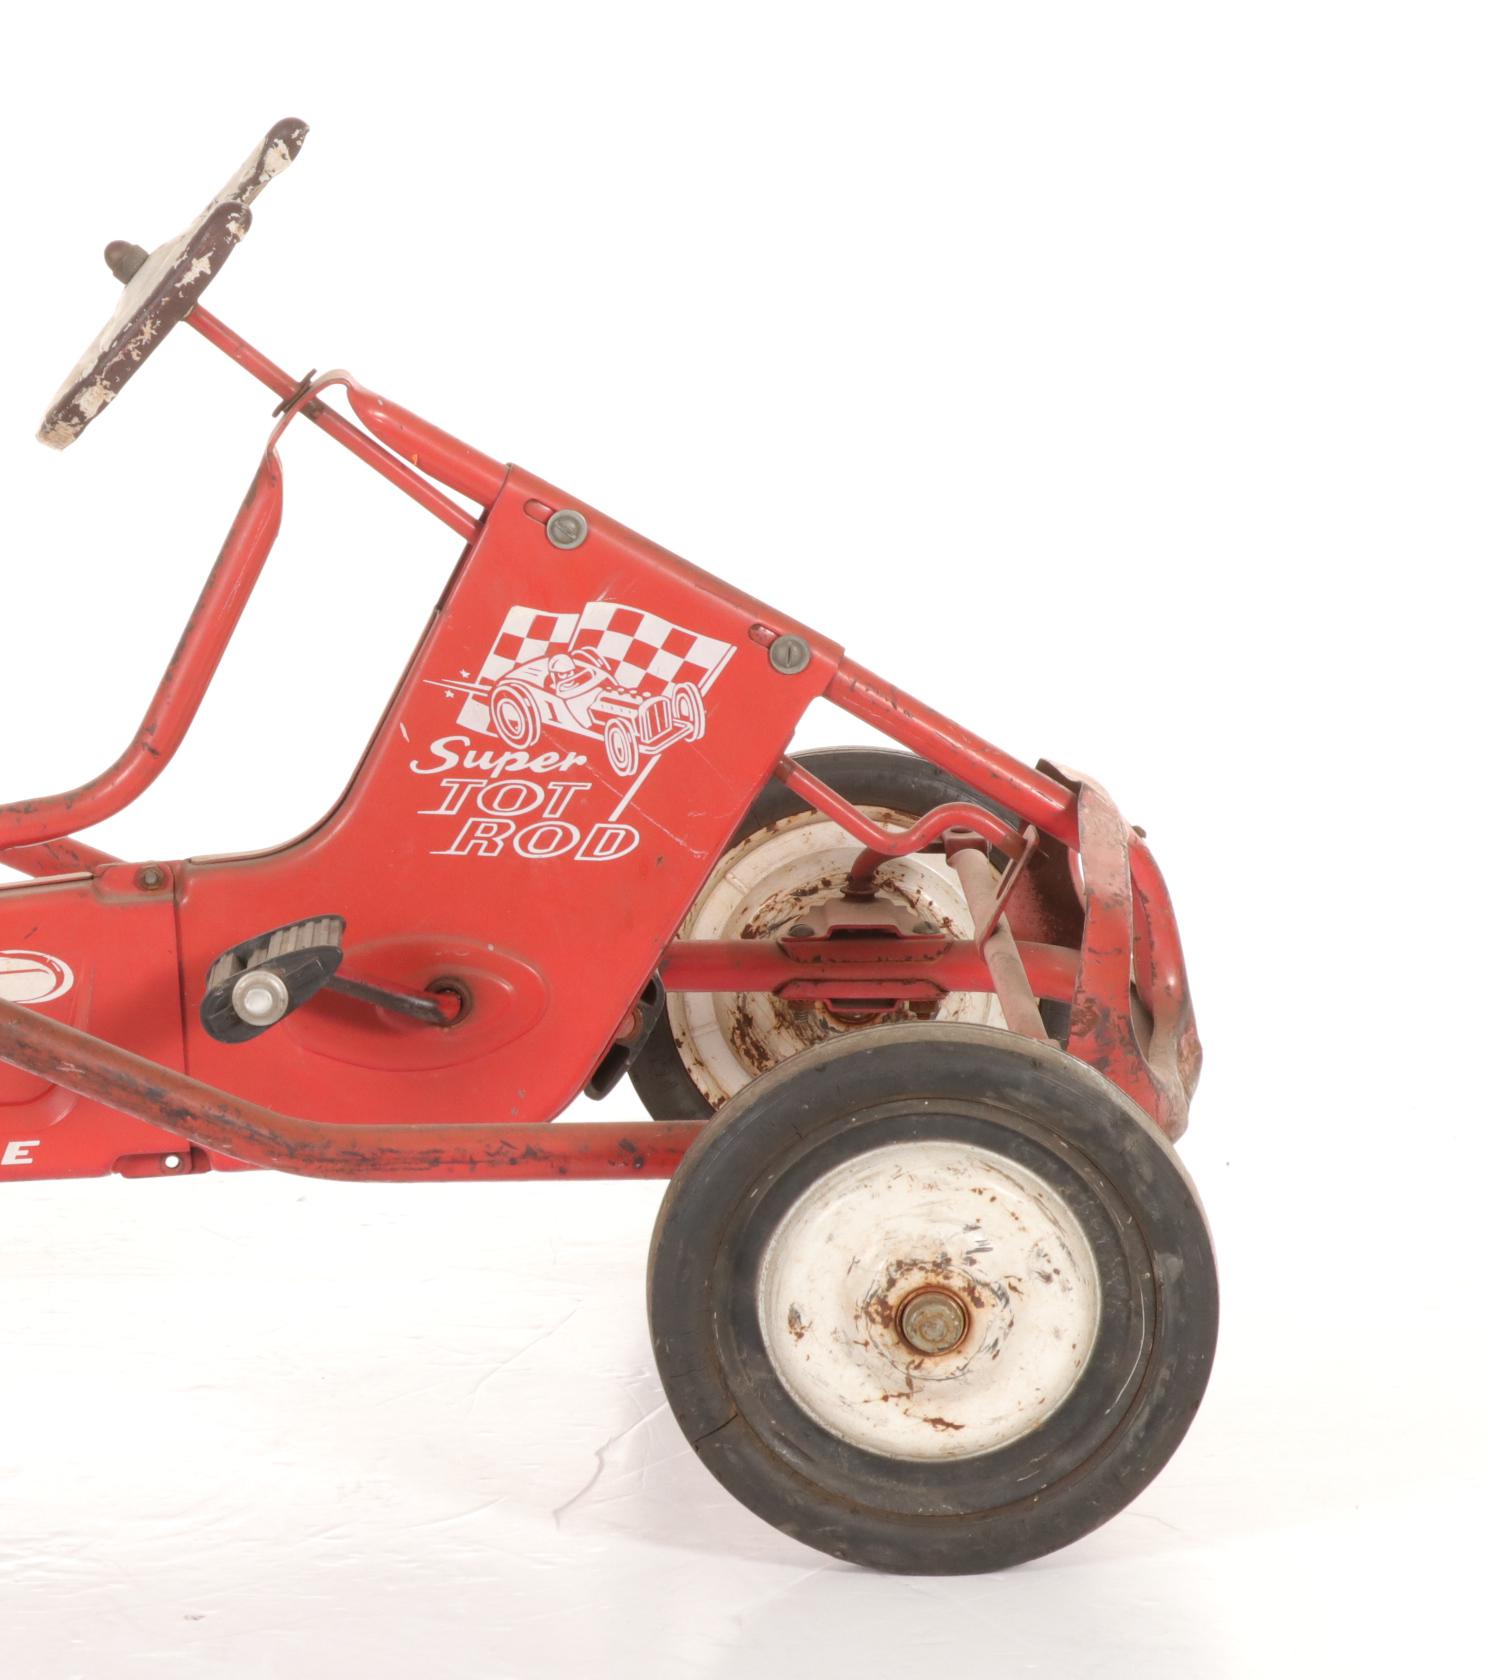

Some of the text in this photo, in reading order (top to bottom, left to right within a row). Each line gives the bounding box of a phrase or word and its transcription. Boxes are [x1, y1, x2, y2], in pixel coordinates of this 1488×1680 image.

[410, 735, 588, 779] Super
[417, 778, 593, 819] TOT
[429, 817, 641, 862] ROD
